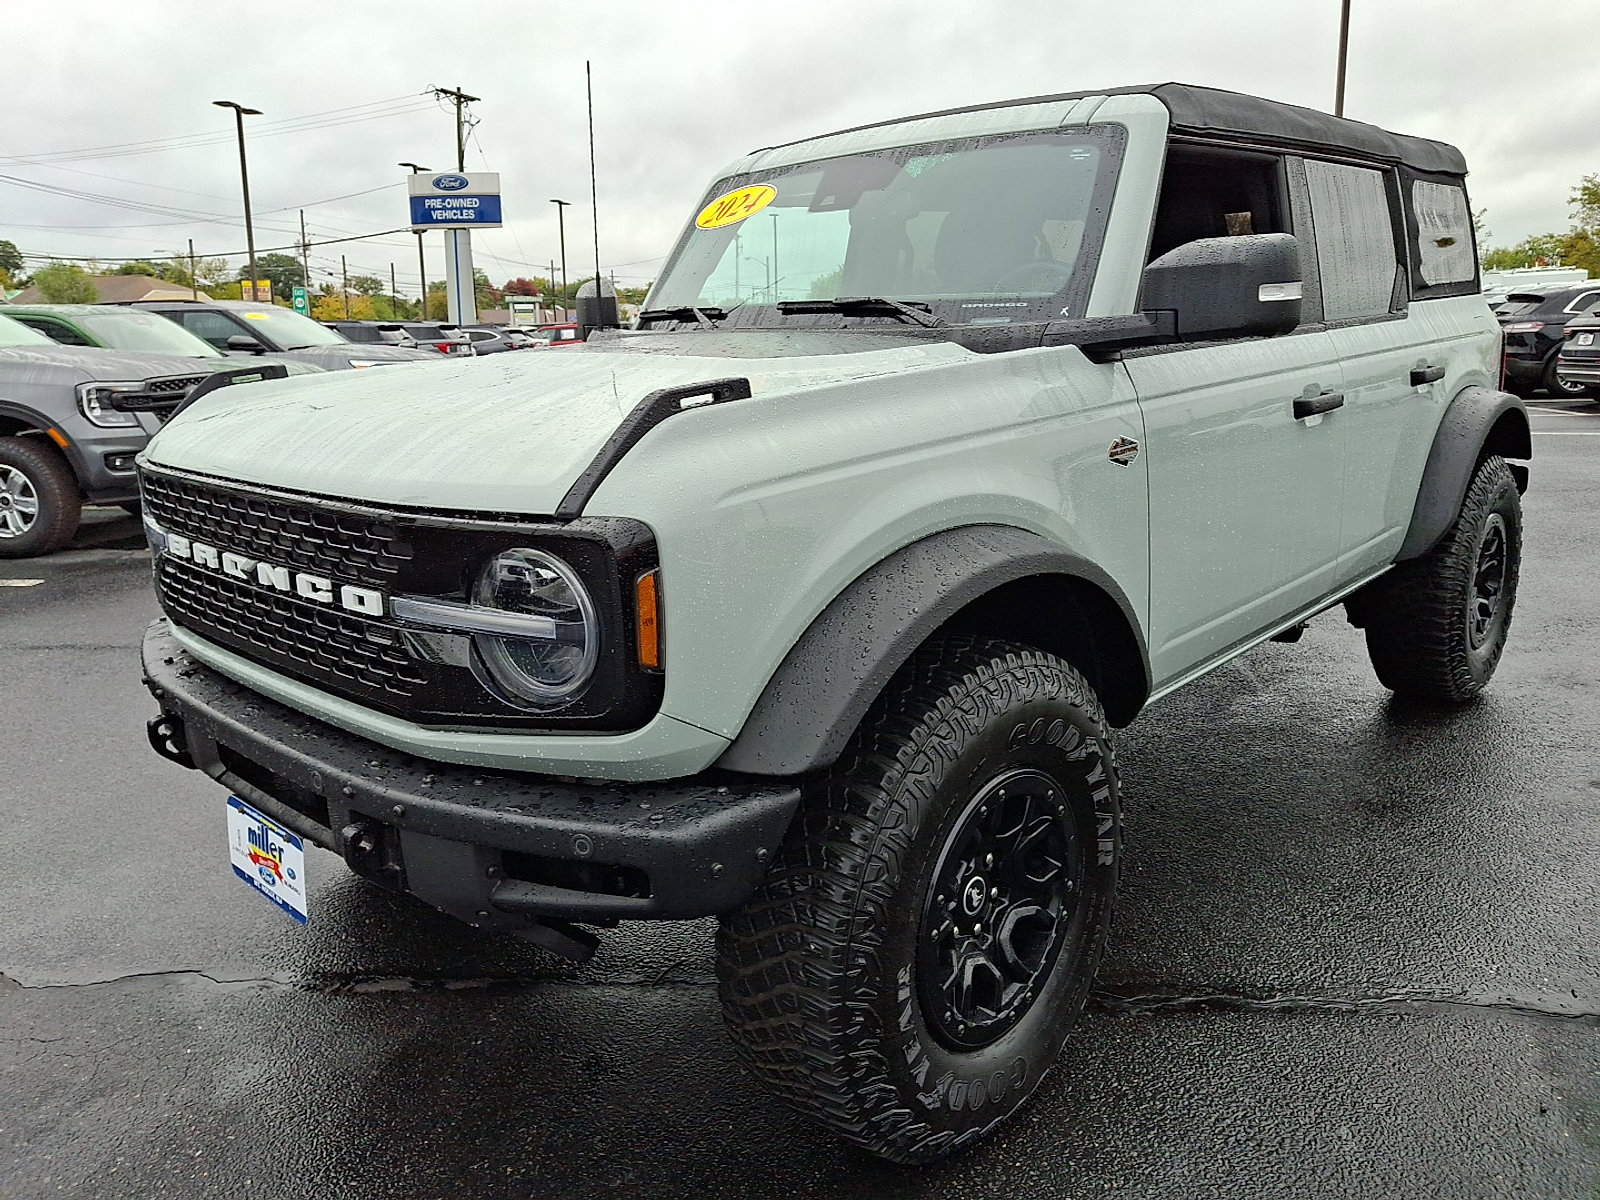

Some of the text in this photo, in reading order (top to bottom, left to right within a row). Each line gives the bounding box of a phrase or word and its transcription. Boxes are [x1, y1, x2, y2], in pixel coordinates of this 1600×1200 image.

[439, 177, 460, 188] Ford
[424, 198, 479, 209] PRE-OWNED
[431, 210, 475, 220] VEHICLES
[702, 189, 768, 225] 2024
[167, 533, 383, 617] BRONCO
[1008, 717, 1116, 867] GOODYEAR
[247, 824, 285, 864] miller
